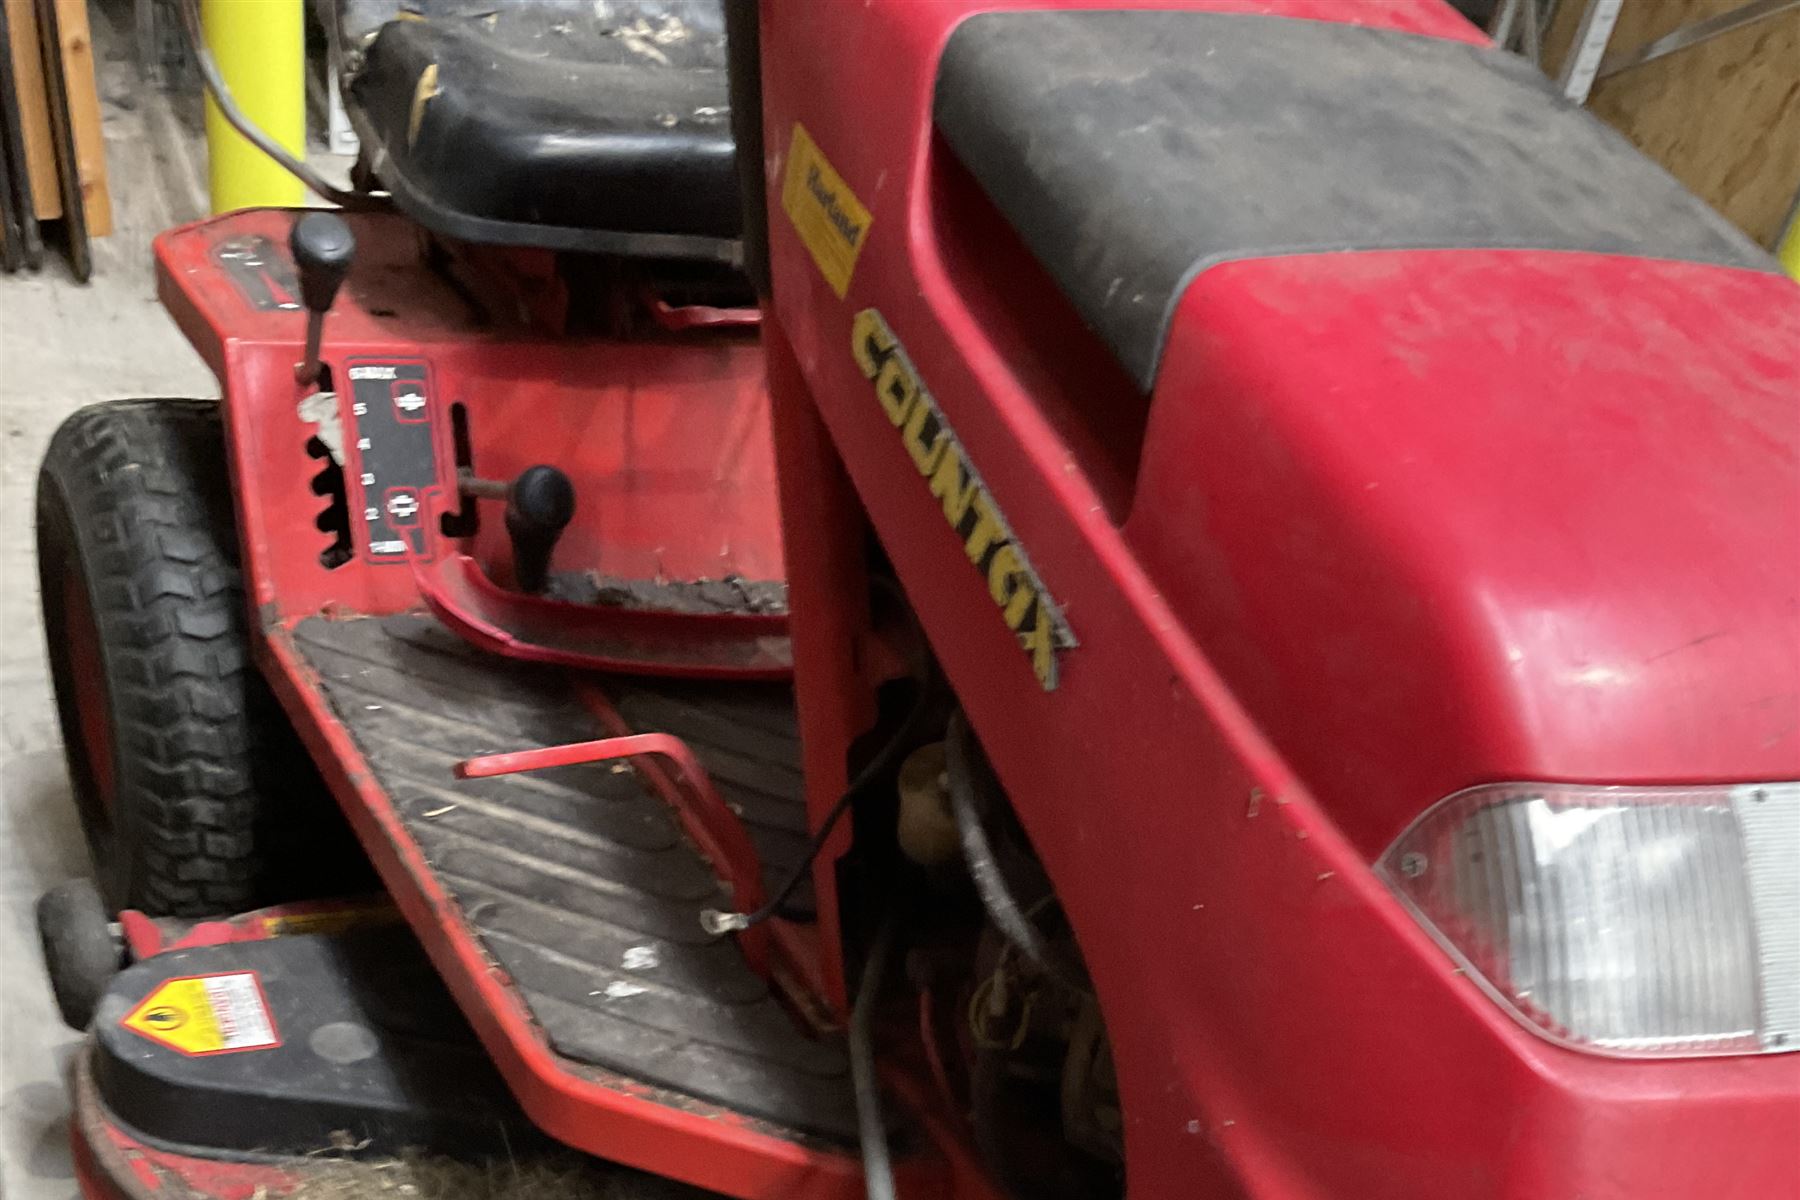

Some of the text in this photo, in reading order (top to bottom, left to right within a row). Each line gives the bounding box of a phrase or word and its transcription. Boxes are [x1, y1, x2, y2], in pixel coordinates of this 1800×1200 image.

[353, 402, 367, 415] 5
[852, 308, 1079, 691] COUNTAX
[365, 508, 379, 520] 2
